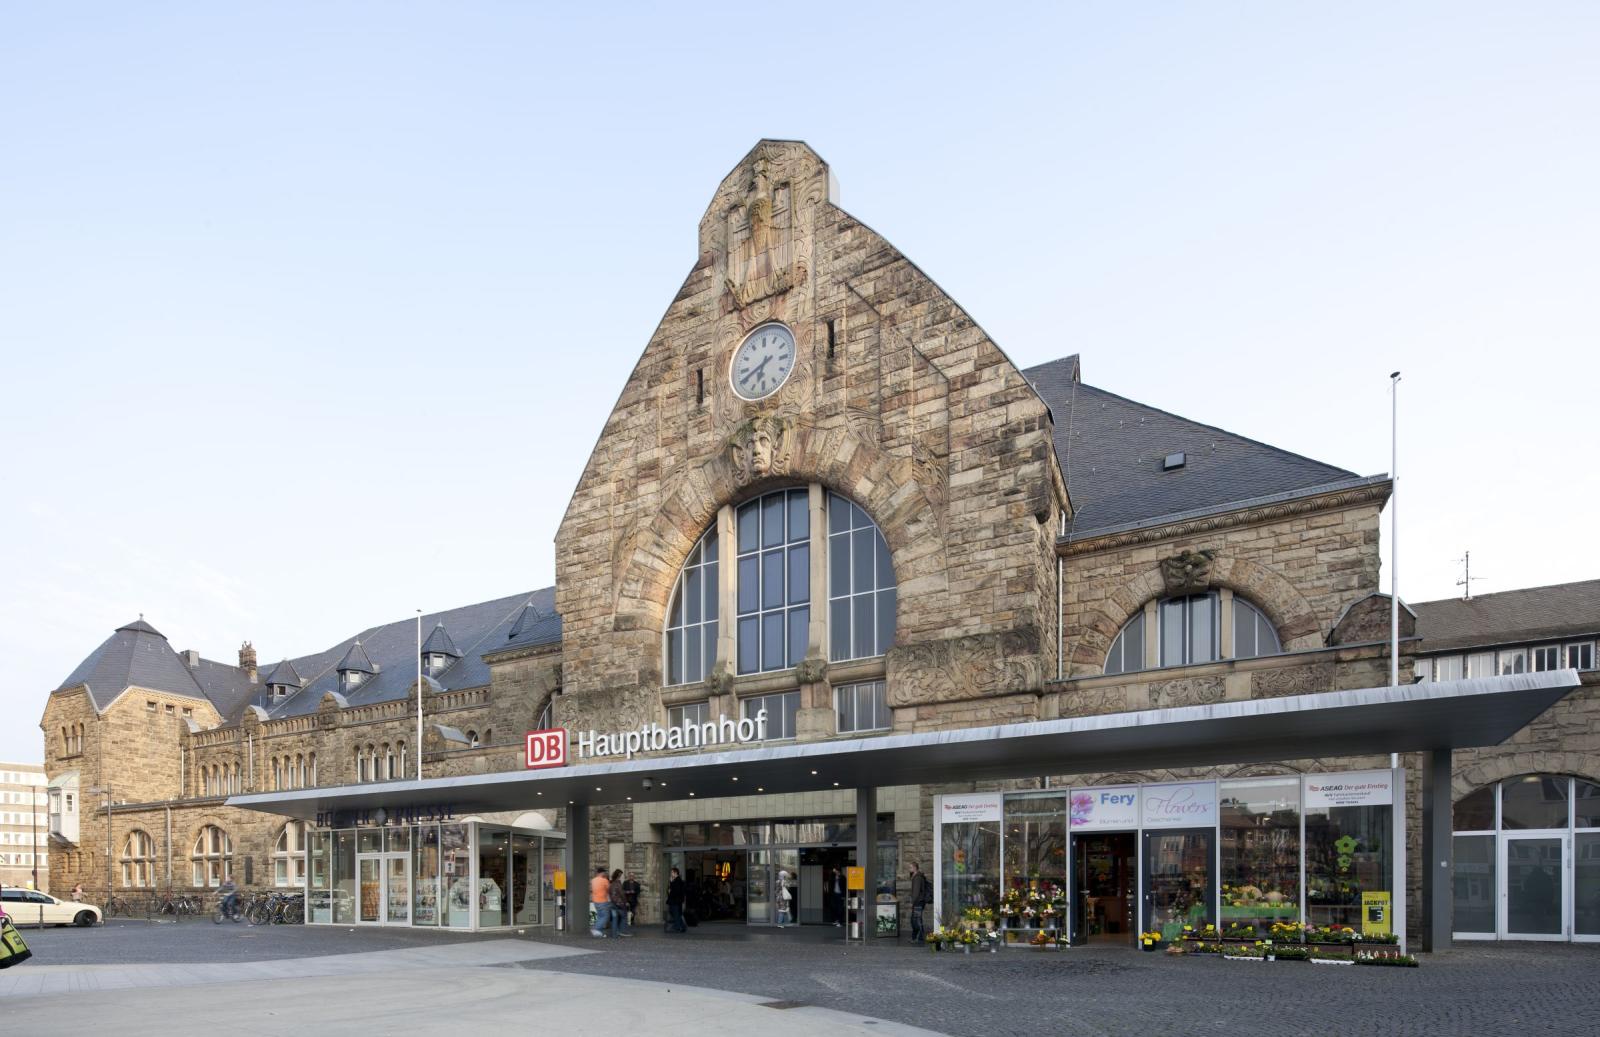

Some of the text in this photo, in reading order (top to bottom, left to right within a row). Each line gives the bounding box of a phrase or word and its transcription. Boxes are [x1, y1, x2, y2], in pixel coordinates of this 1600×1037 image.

[530, 709, 768, 763] DB Hauptbahnhof
[1100, 793, 1135, 806] Fery
[1146, 787, 1209, 814] Flowers
